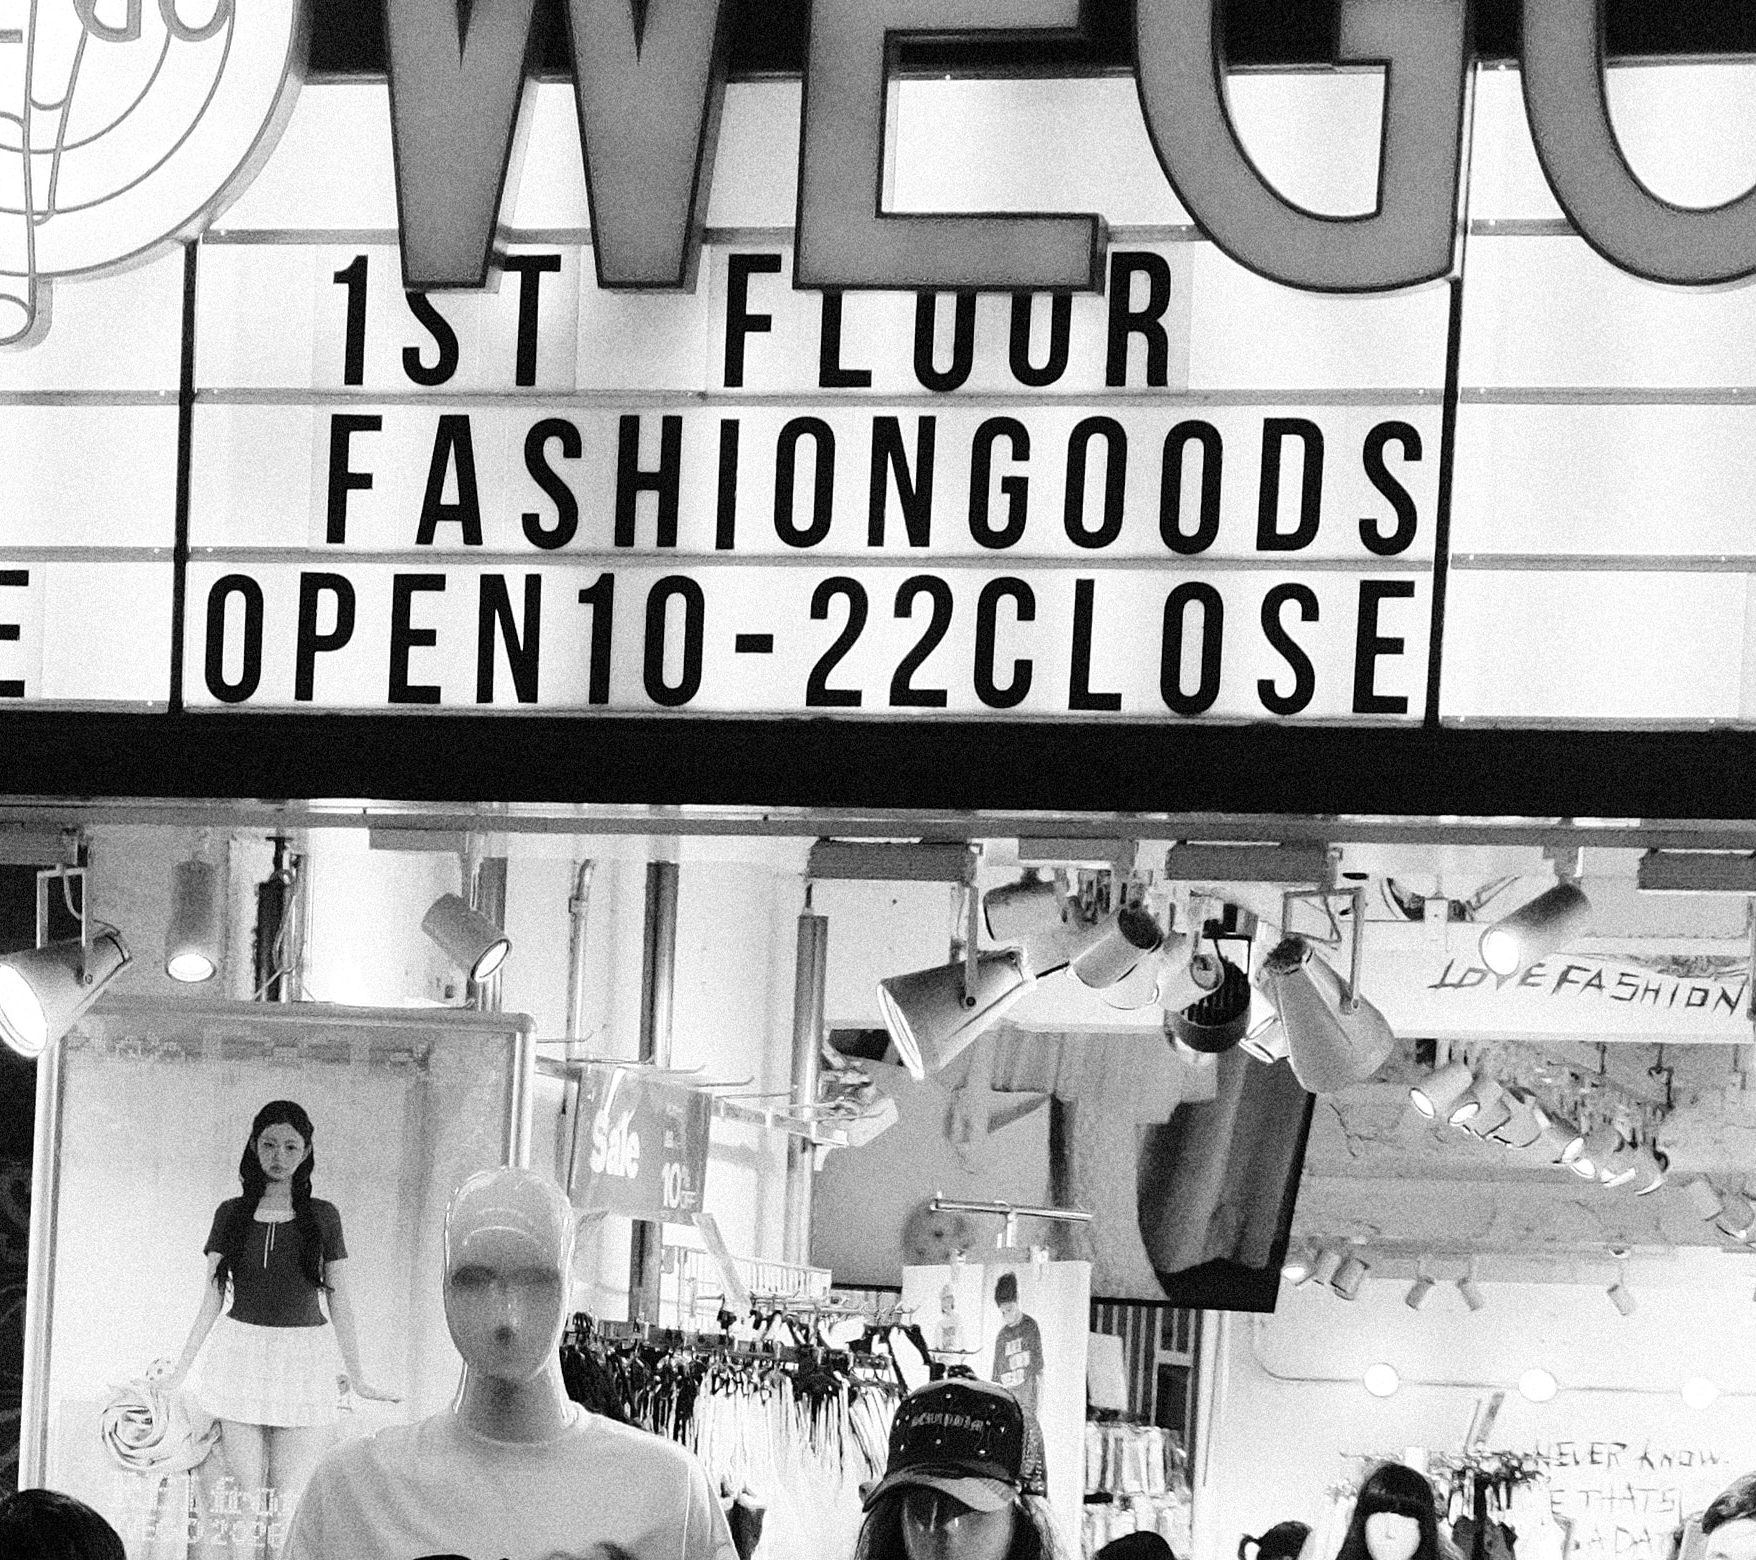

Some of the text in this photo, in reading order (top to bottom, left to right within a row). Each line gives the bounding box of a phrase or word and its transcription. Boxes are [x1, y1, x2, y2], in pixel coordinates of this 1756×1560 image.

[333, 252, 1172, 393] 1ST FLOOR
[1551, 963, 1750, 1016] FASHION
[589, 1108, 641, 1179] Sale
